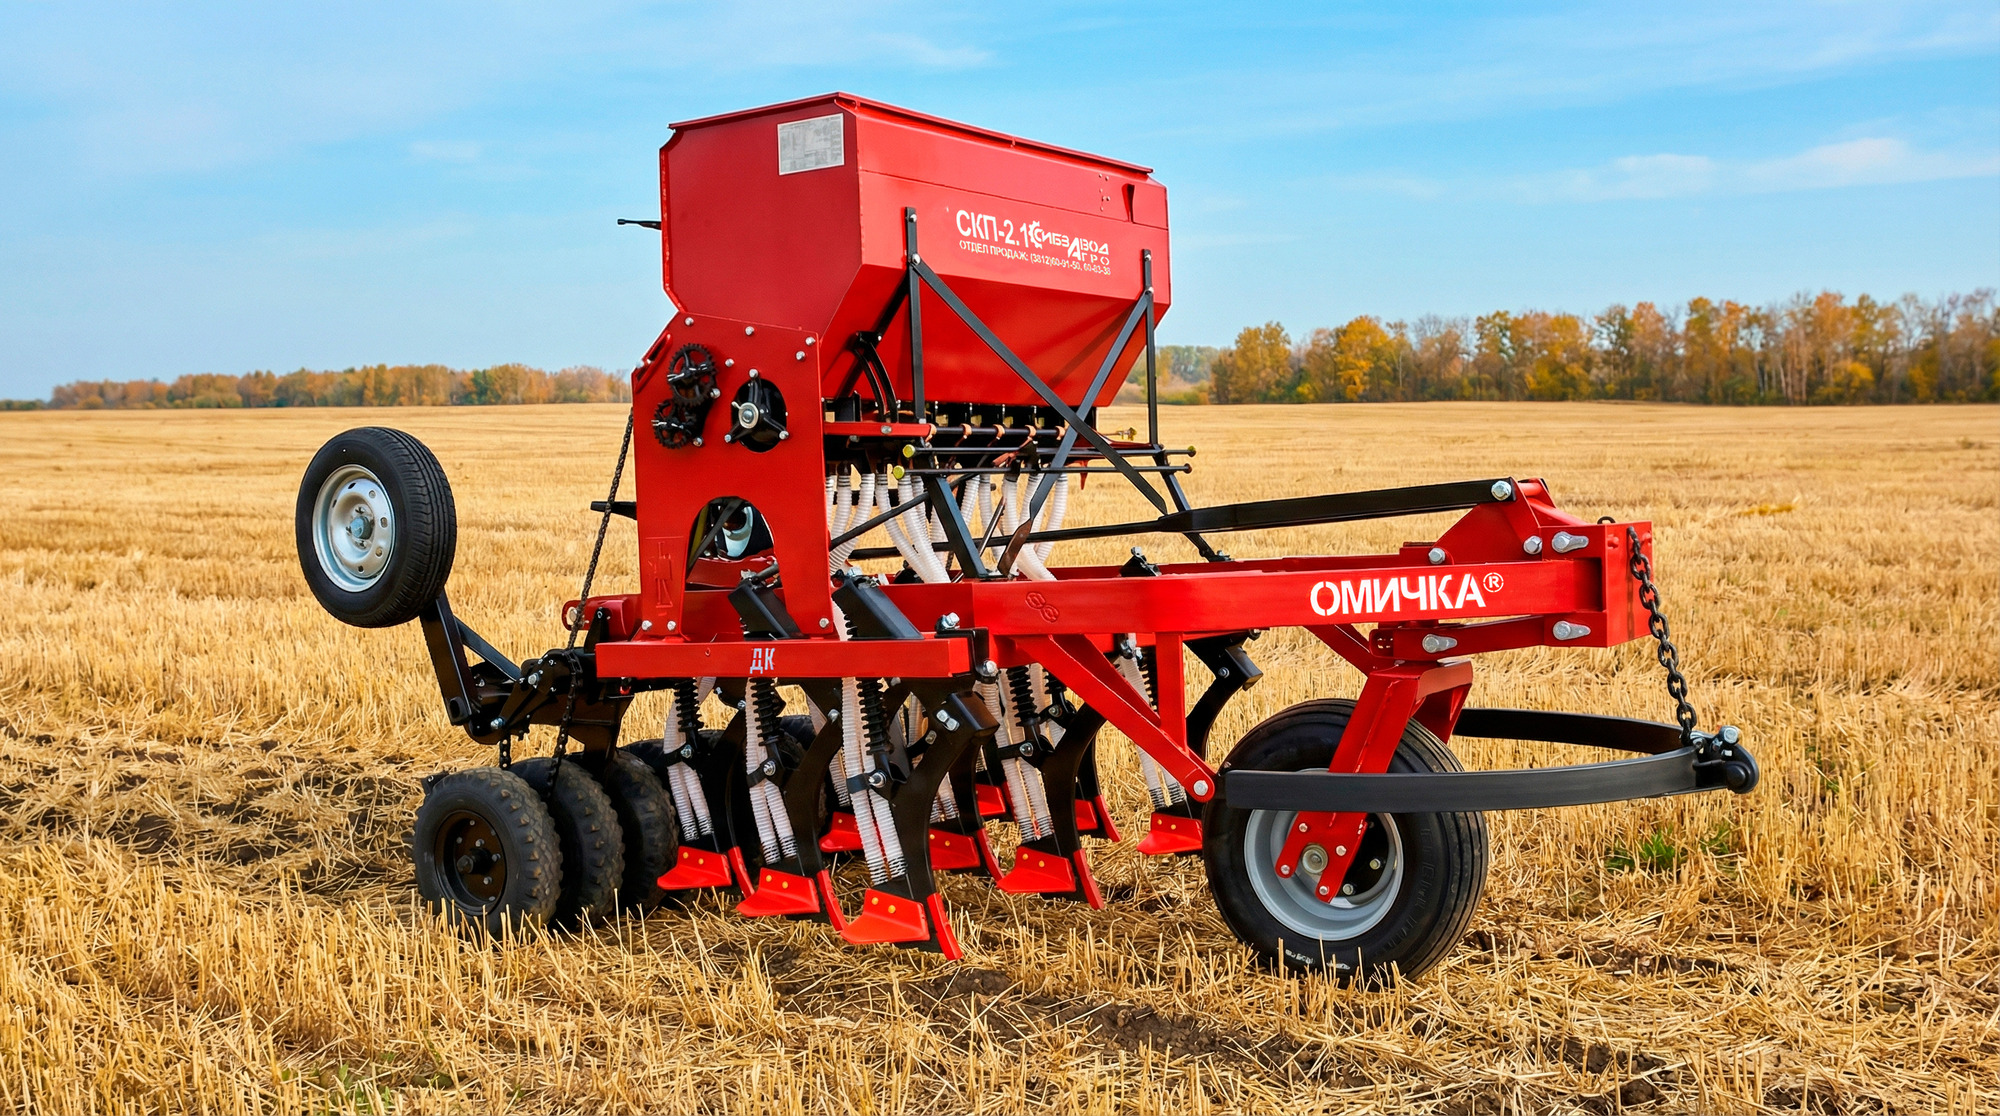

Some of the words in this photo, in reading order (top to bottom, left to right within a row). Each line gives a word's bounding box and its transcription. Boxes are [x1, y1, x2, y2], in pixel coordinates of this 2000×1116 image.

[956, 210, 1029, 248] СКП-2.1
[959, 240, 989, 254] ОТДЕЛ
[990, 245, 1029, 262] ПРОДАЖ:
[749, 648, 776, 675] ДК
